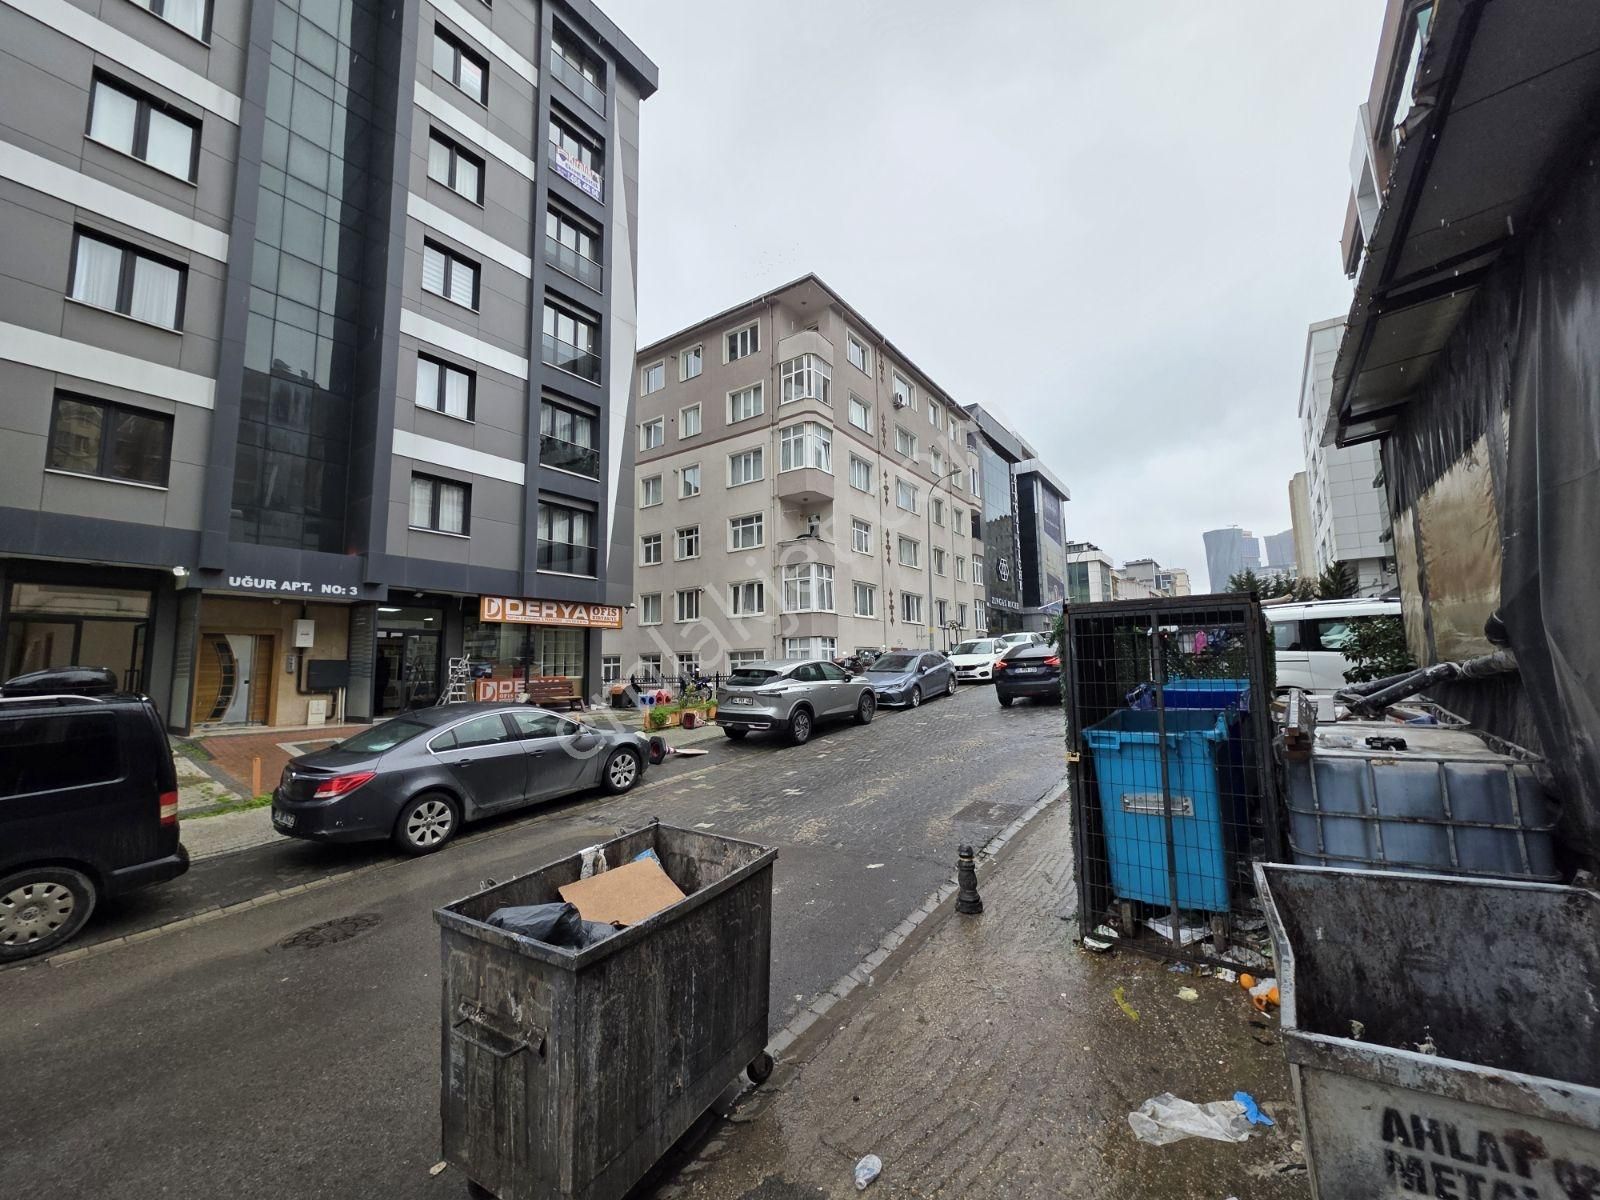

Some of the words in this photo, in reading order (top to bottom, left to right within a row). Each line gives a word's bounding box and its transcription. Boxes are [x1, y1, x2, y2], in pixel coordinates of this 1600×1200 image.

[229, 576, 276, 589] UĞUR
[280, 581, 313, 592] APT.
[321, 584, 346, 595] NO:
[349, 586, 358, 595] 3
[505, 599, 589, 619] DERYA
